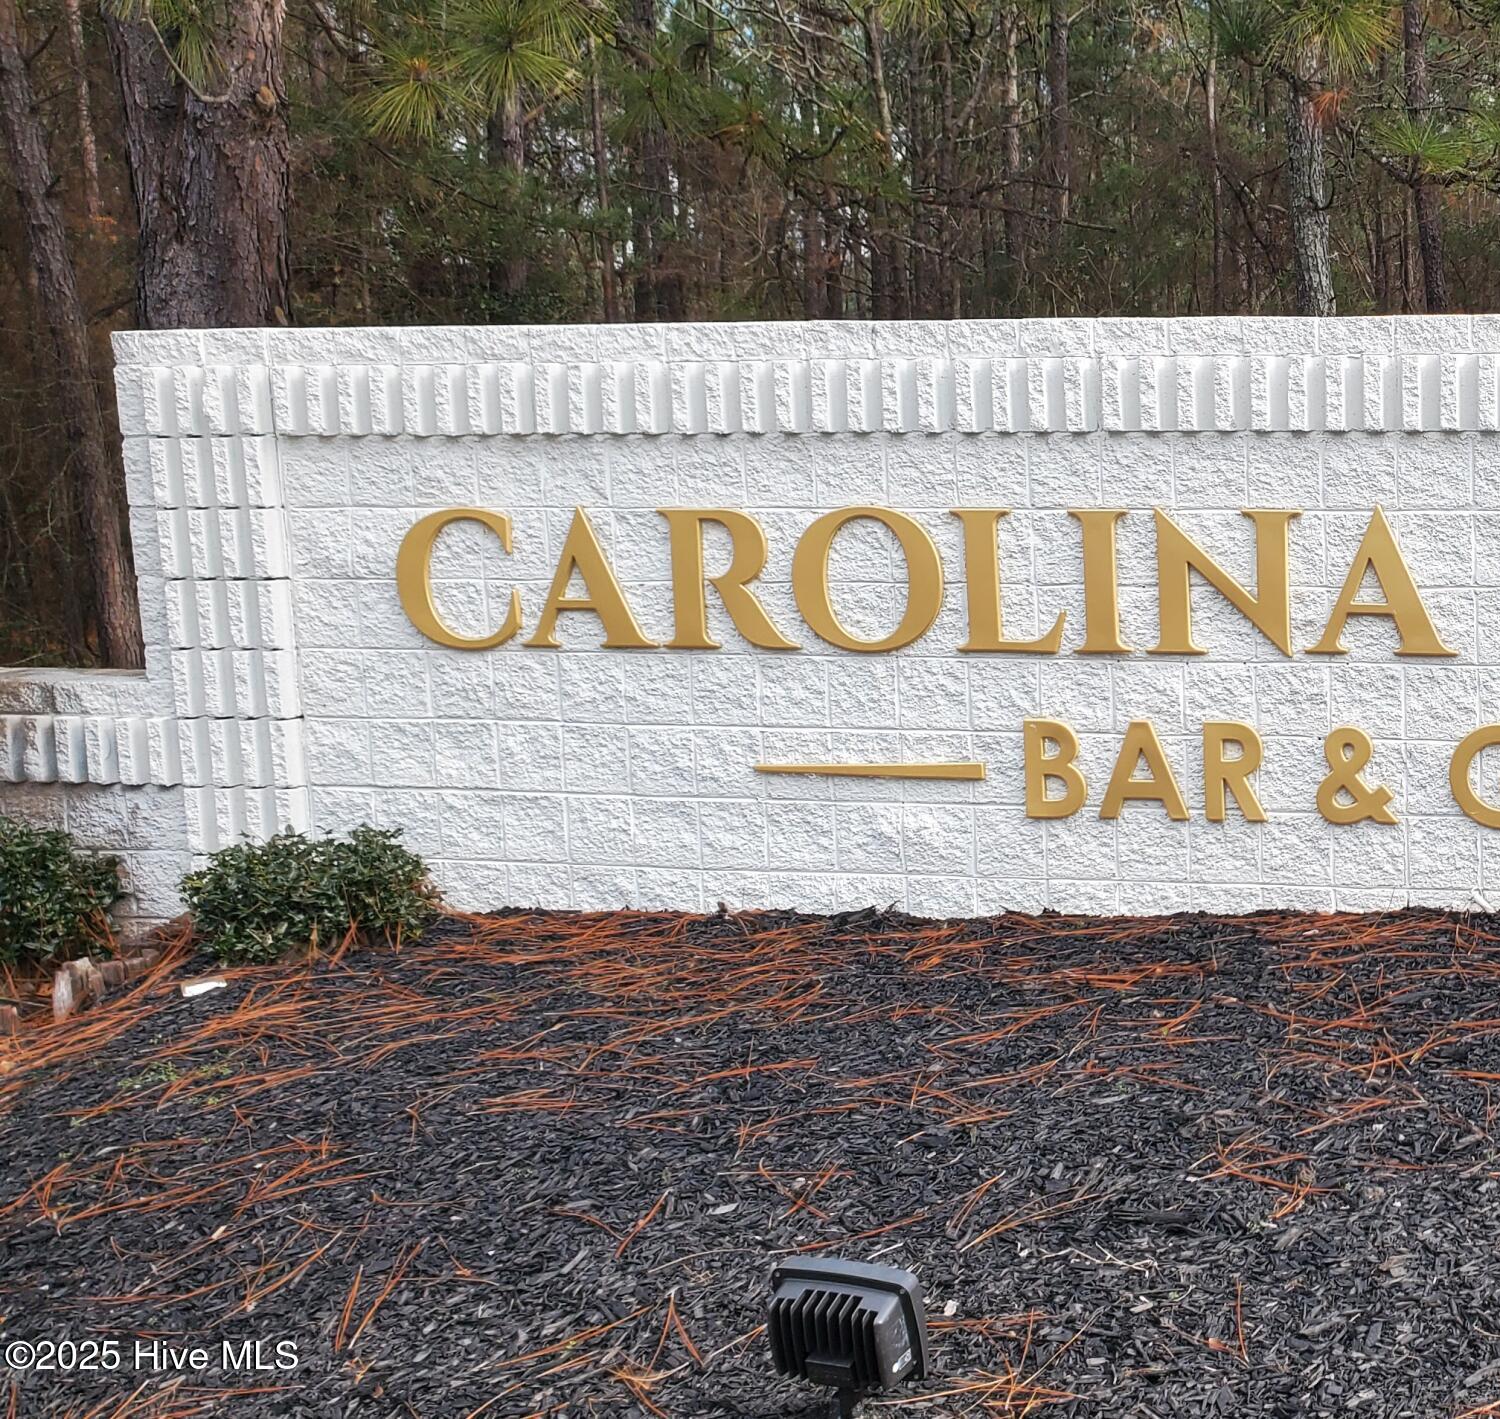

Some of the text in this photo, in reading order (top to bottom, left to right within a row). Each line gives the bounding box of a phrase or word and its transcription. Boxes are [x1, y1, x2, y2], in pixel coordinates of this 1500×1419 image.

[396, 506, 1456, 658] CAROLINA
[1023, 720, 1266, 823] BAR
[1315, 727, 1397, 826] &
